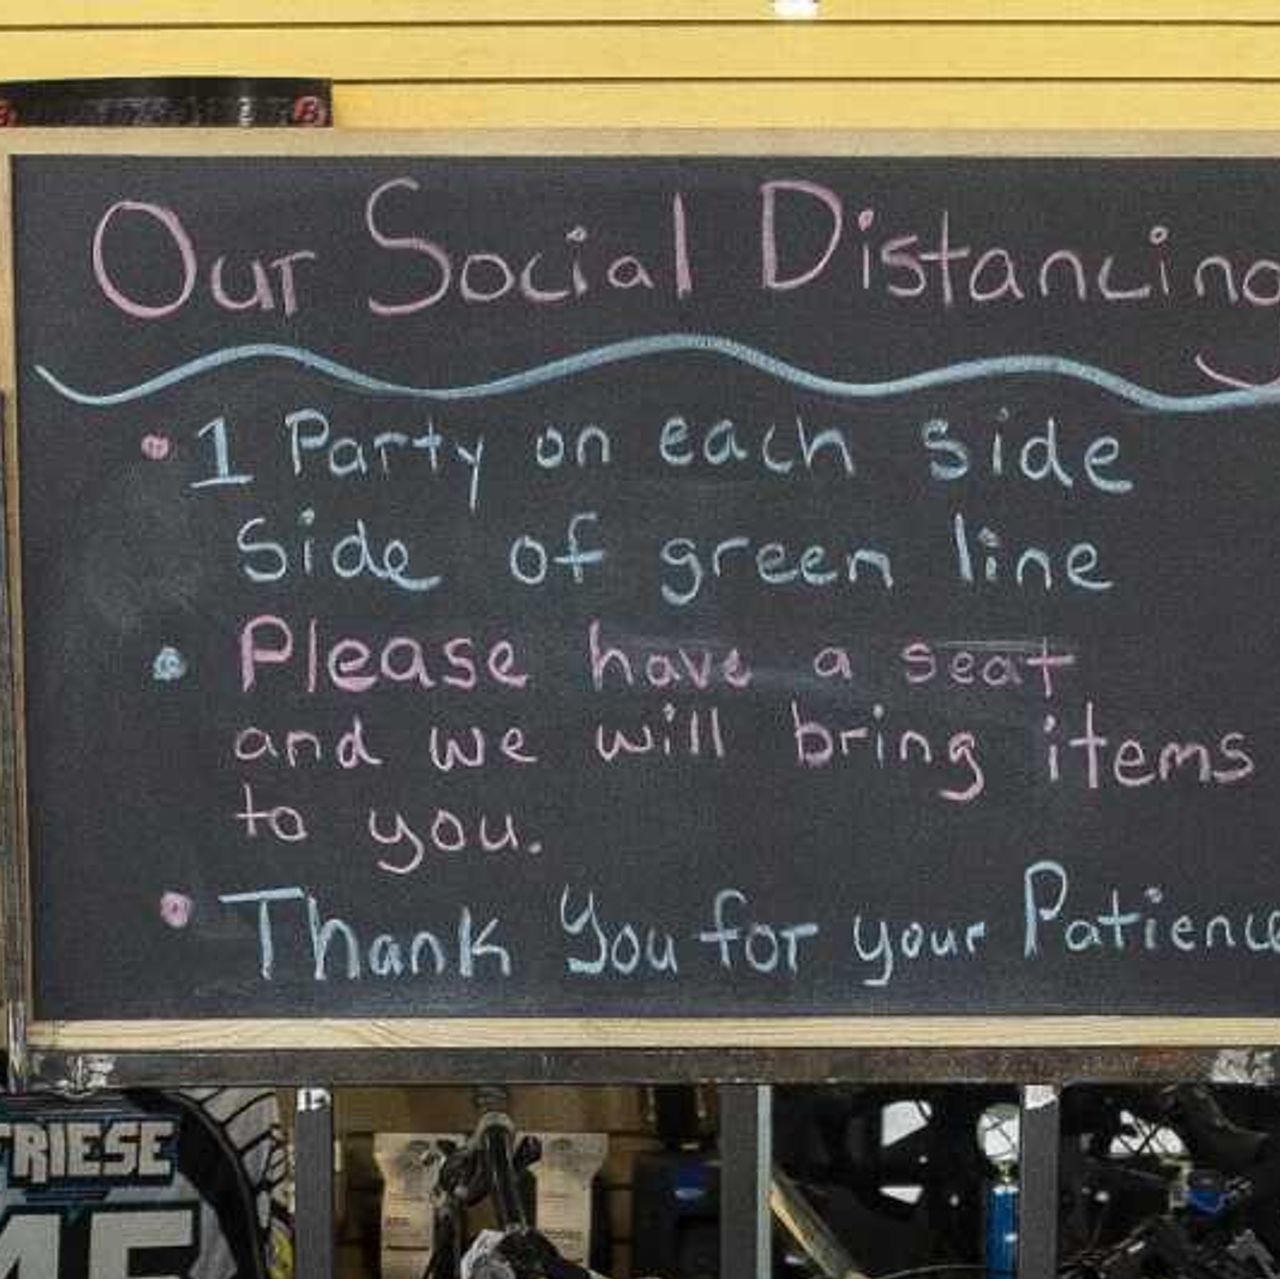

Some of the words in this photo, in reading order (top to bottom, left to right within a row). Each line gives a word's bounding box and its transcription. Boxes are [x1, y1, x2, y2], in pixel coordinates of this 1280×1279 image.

[93, 200, 315, 318] Our
[367, 177, 692, 317] Social
[190, 416, 254, 488] 1
[285, 407, 485, 510] Party
[536, 424, 611, 468] on
[660, 414, 856, 476] each
[510, 512, 604, 586] of
[661, 536, 895, 604] green
[953, 511, 1113, 590] line
[238, 614, 530, 694] Please
[587, 619, 754, 692] have
[813, 645, 854, 680] a
[901, 636, 1075, 698] seat
[234, 714, 383, 769] and
[429, 724, 539, 772] we
[595, 702, 725, 760] will
[791, 700, 985, 800] bring
[1043, 700, 1255, 790] items
[236, 783, 309, 842] to
[368, 807, 544, 874] you.
[219, 887, 511, 982] Thank
[699, 889, 818, 974] for
[852, 915, 988, 988] your
